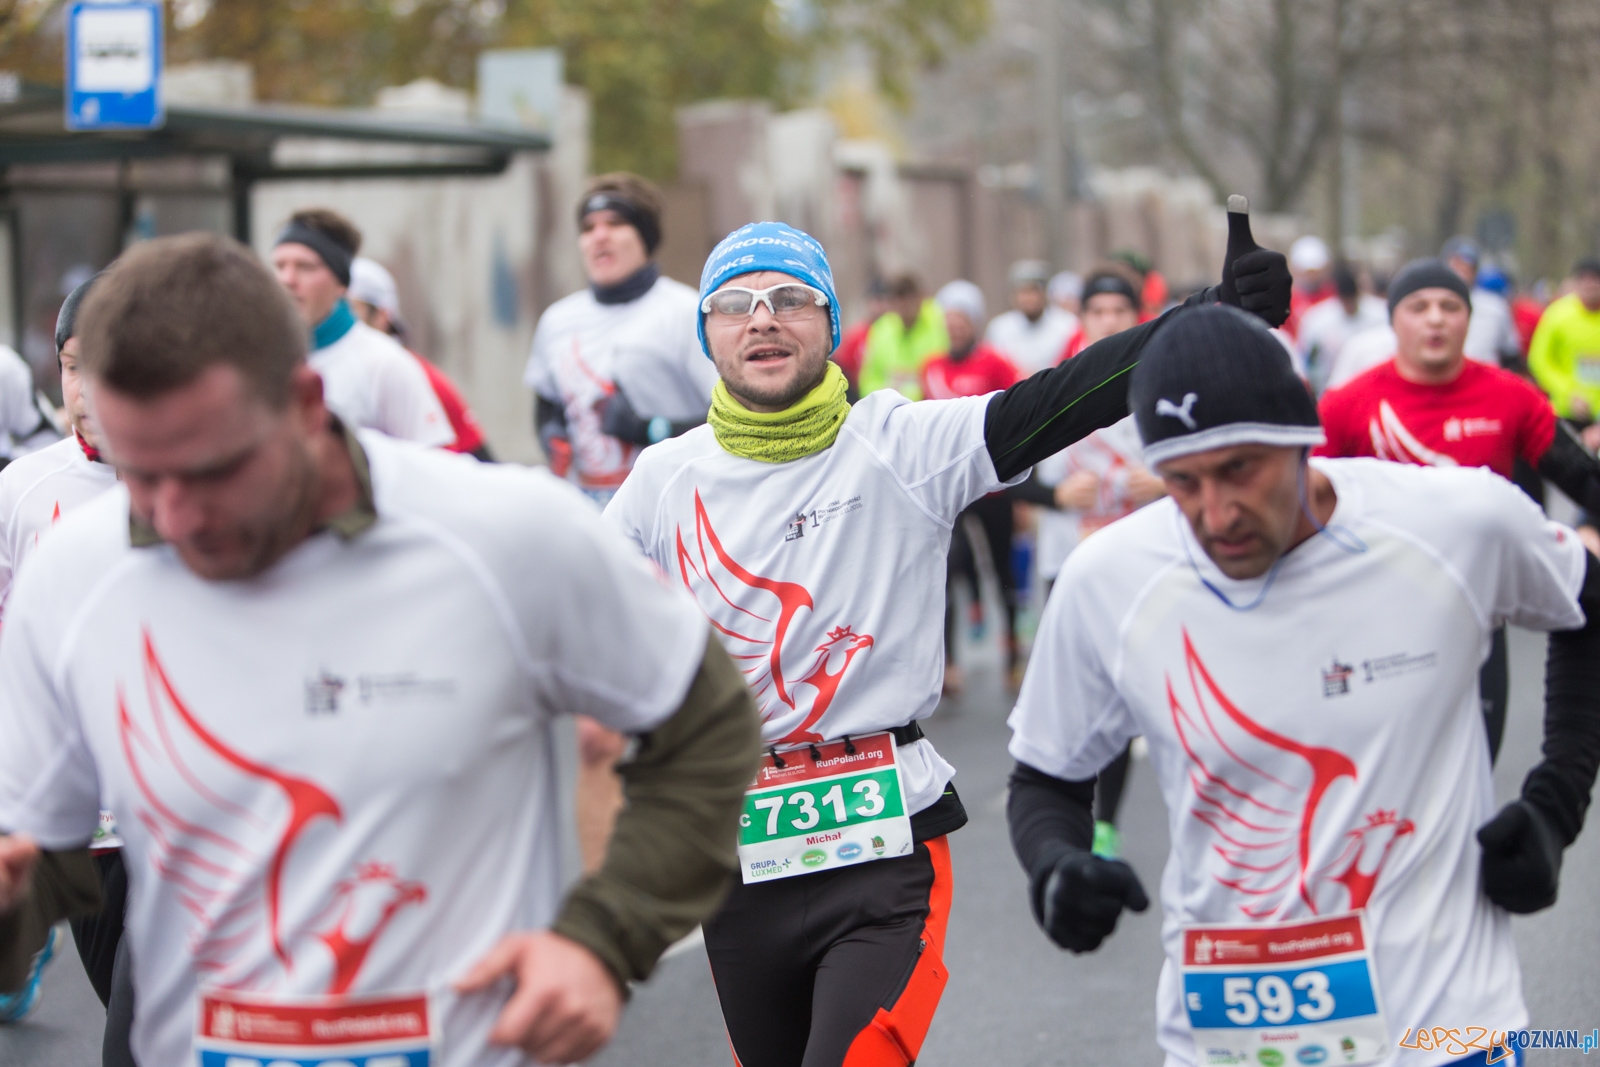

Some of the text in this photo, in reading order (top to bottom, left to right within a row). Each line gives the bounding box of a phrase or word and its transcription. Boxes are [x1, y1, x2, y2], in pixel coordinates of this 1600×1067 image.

[816, 749, 883, 769] RunPoland.org
[754, 779, 885, 836] 7313
[806, 831, 842, 845] Michał
[750, 859, 777, 870] GRUPA
[751, 866, 783, 877] LUXMED
[1187, 991, 1203, 1011] E
[1223, 970, 1336, 1026] 593
